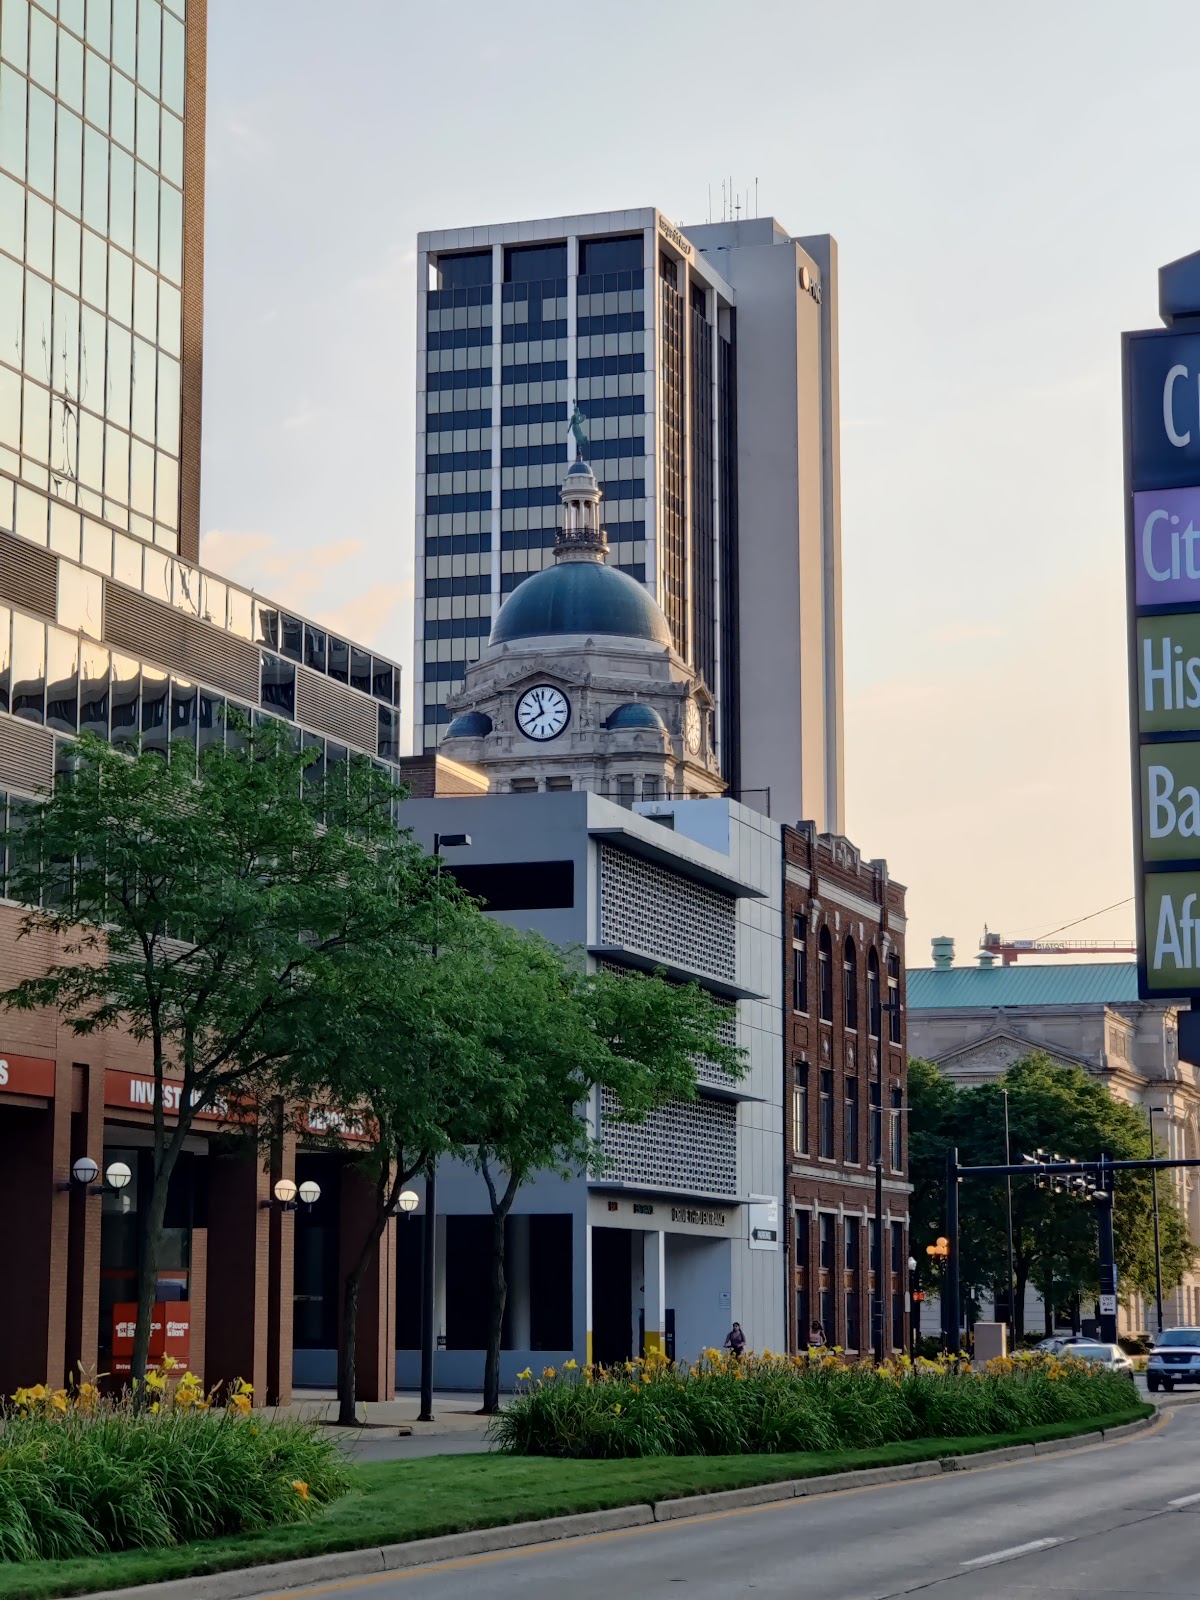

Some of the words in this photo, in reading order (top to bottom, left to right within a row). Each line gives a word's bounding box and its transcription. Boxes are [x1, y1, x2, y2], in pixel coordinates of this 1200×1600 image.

[1163, 364, 1200, 447] C
[1143, 637, 1200, 712] His
[1148, 765, 1200, 839] Ba
